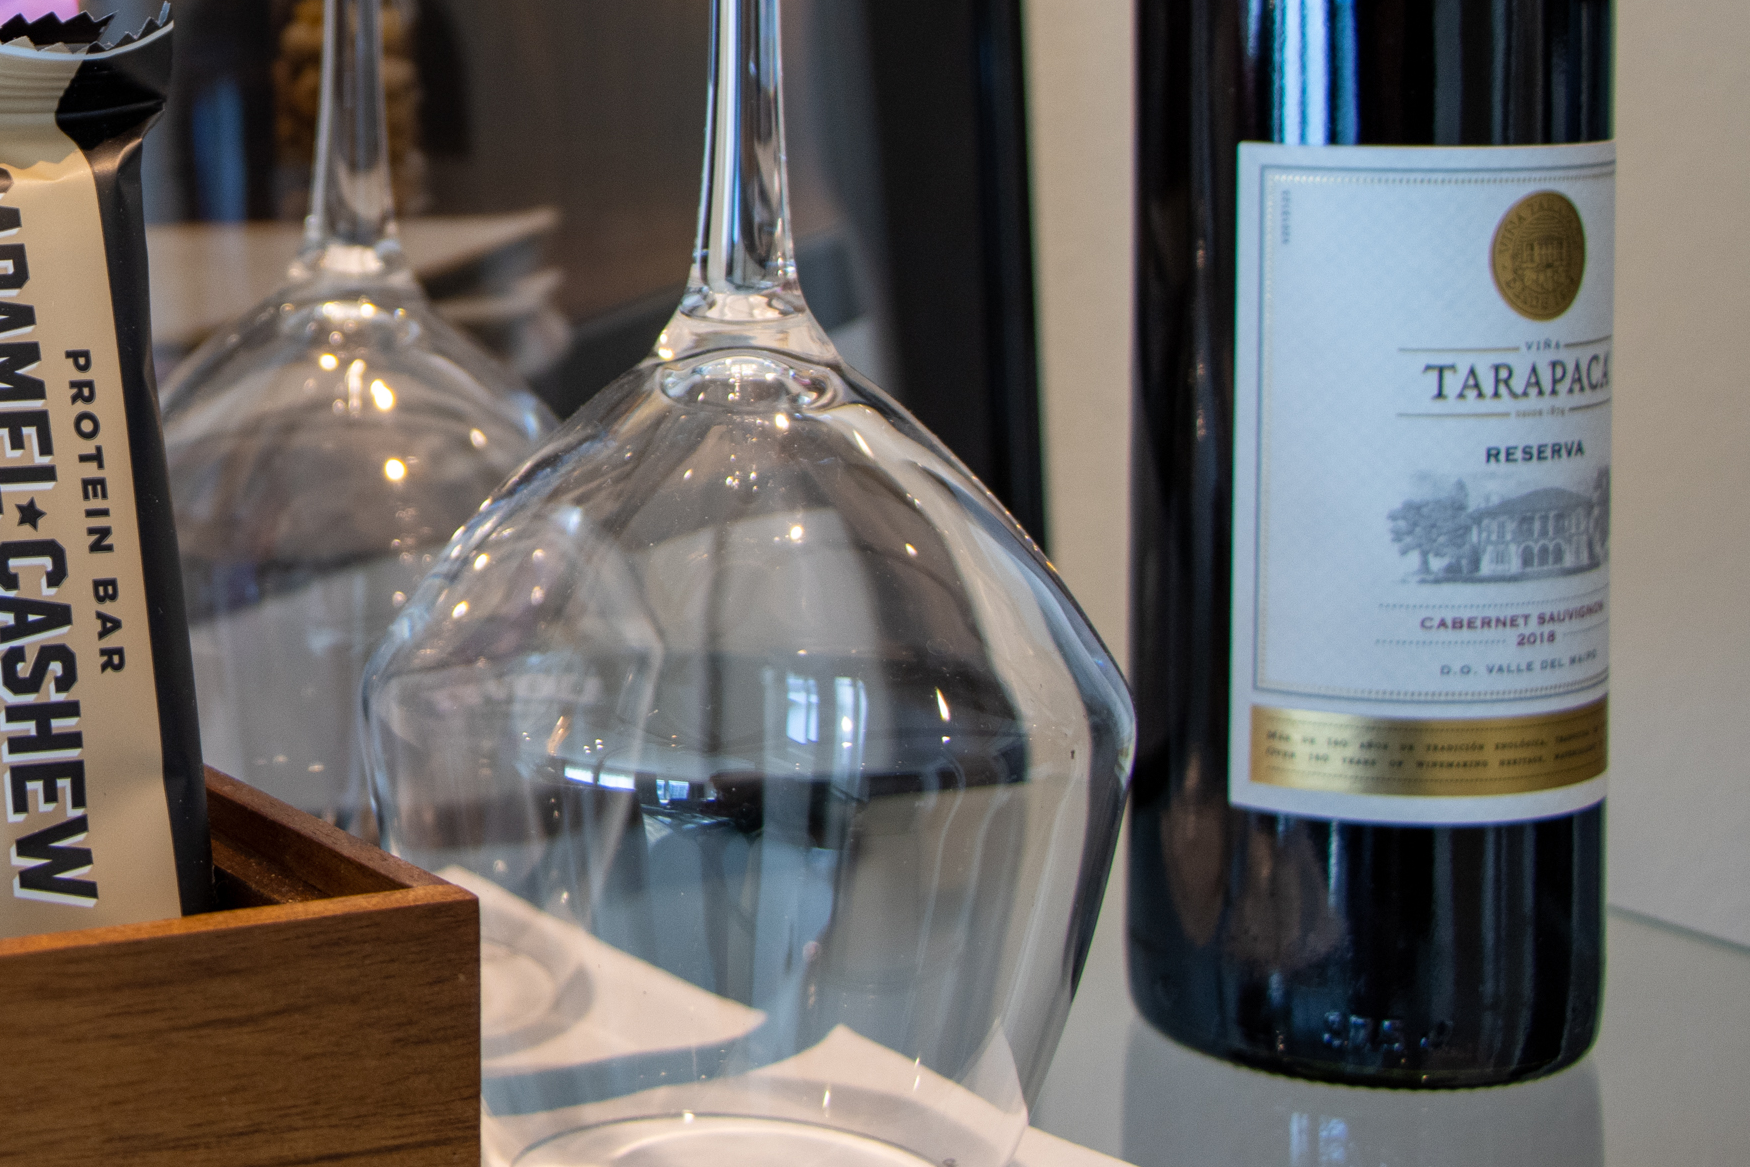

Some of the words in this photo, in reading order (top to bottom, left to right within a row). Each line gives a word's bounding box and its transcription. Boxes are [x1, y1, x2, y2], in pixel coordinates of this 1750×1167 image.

[1525, 337, 1561, 352] VIÑA
[1485, 440, 1586, 465] RESERVA
[63, 348, 115, 555] PROTEIN
[92, 577, 126, 675] BAR
[1419, 613, 1532, 631] CABERNET
[1486, 660, 1535, 675] VALLE
[1540, 656, 1564, 671] DEL
